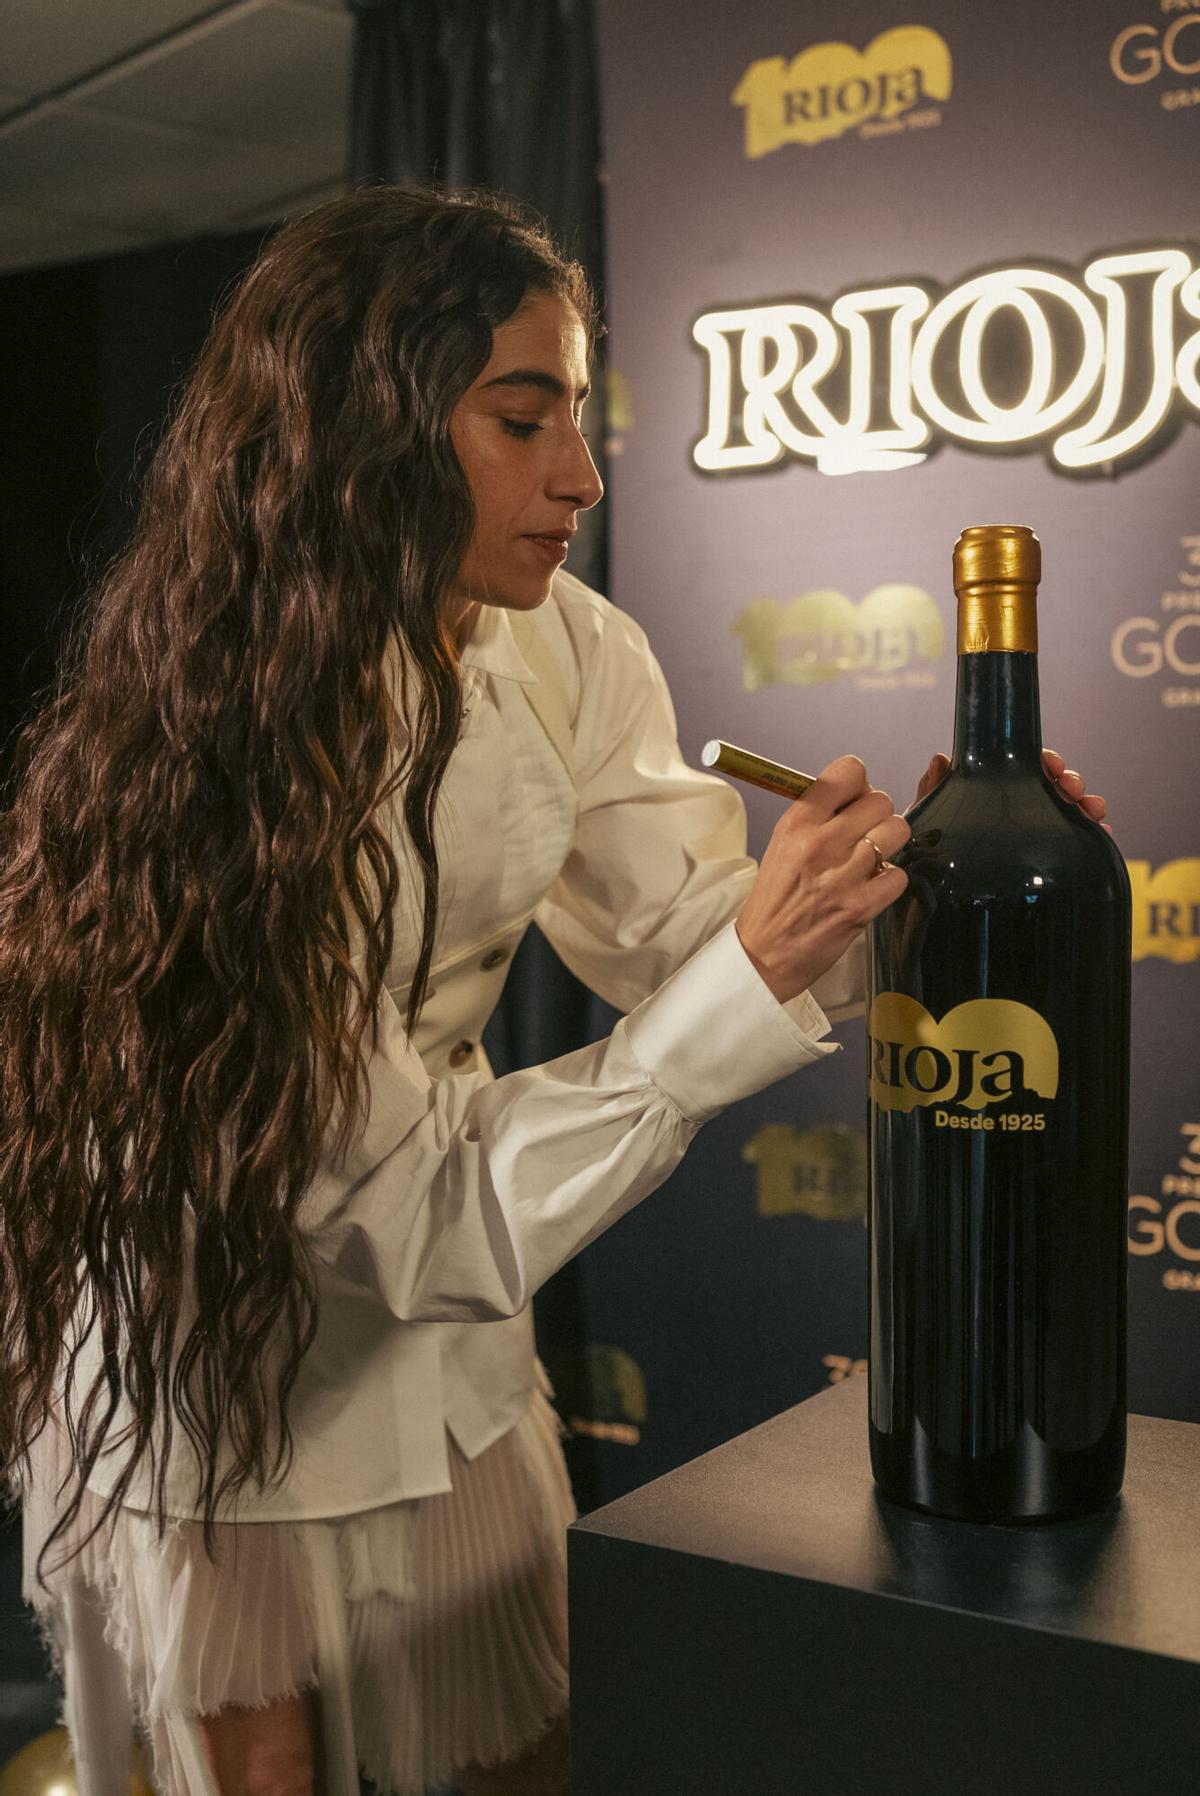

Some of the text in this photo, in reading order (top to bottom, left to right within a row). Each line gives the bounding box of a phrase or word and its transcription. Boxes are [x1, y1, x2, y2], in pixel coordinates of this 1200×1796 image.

[693, 249, 1200, 472] RIOJ
[935, 1110, 1046, 1131] Desde 1925
